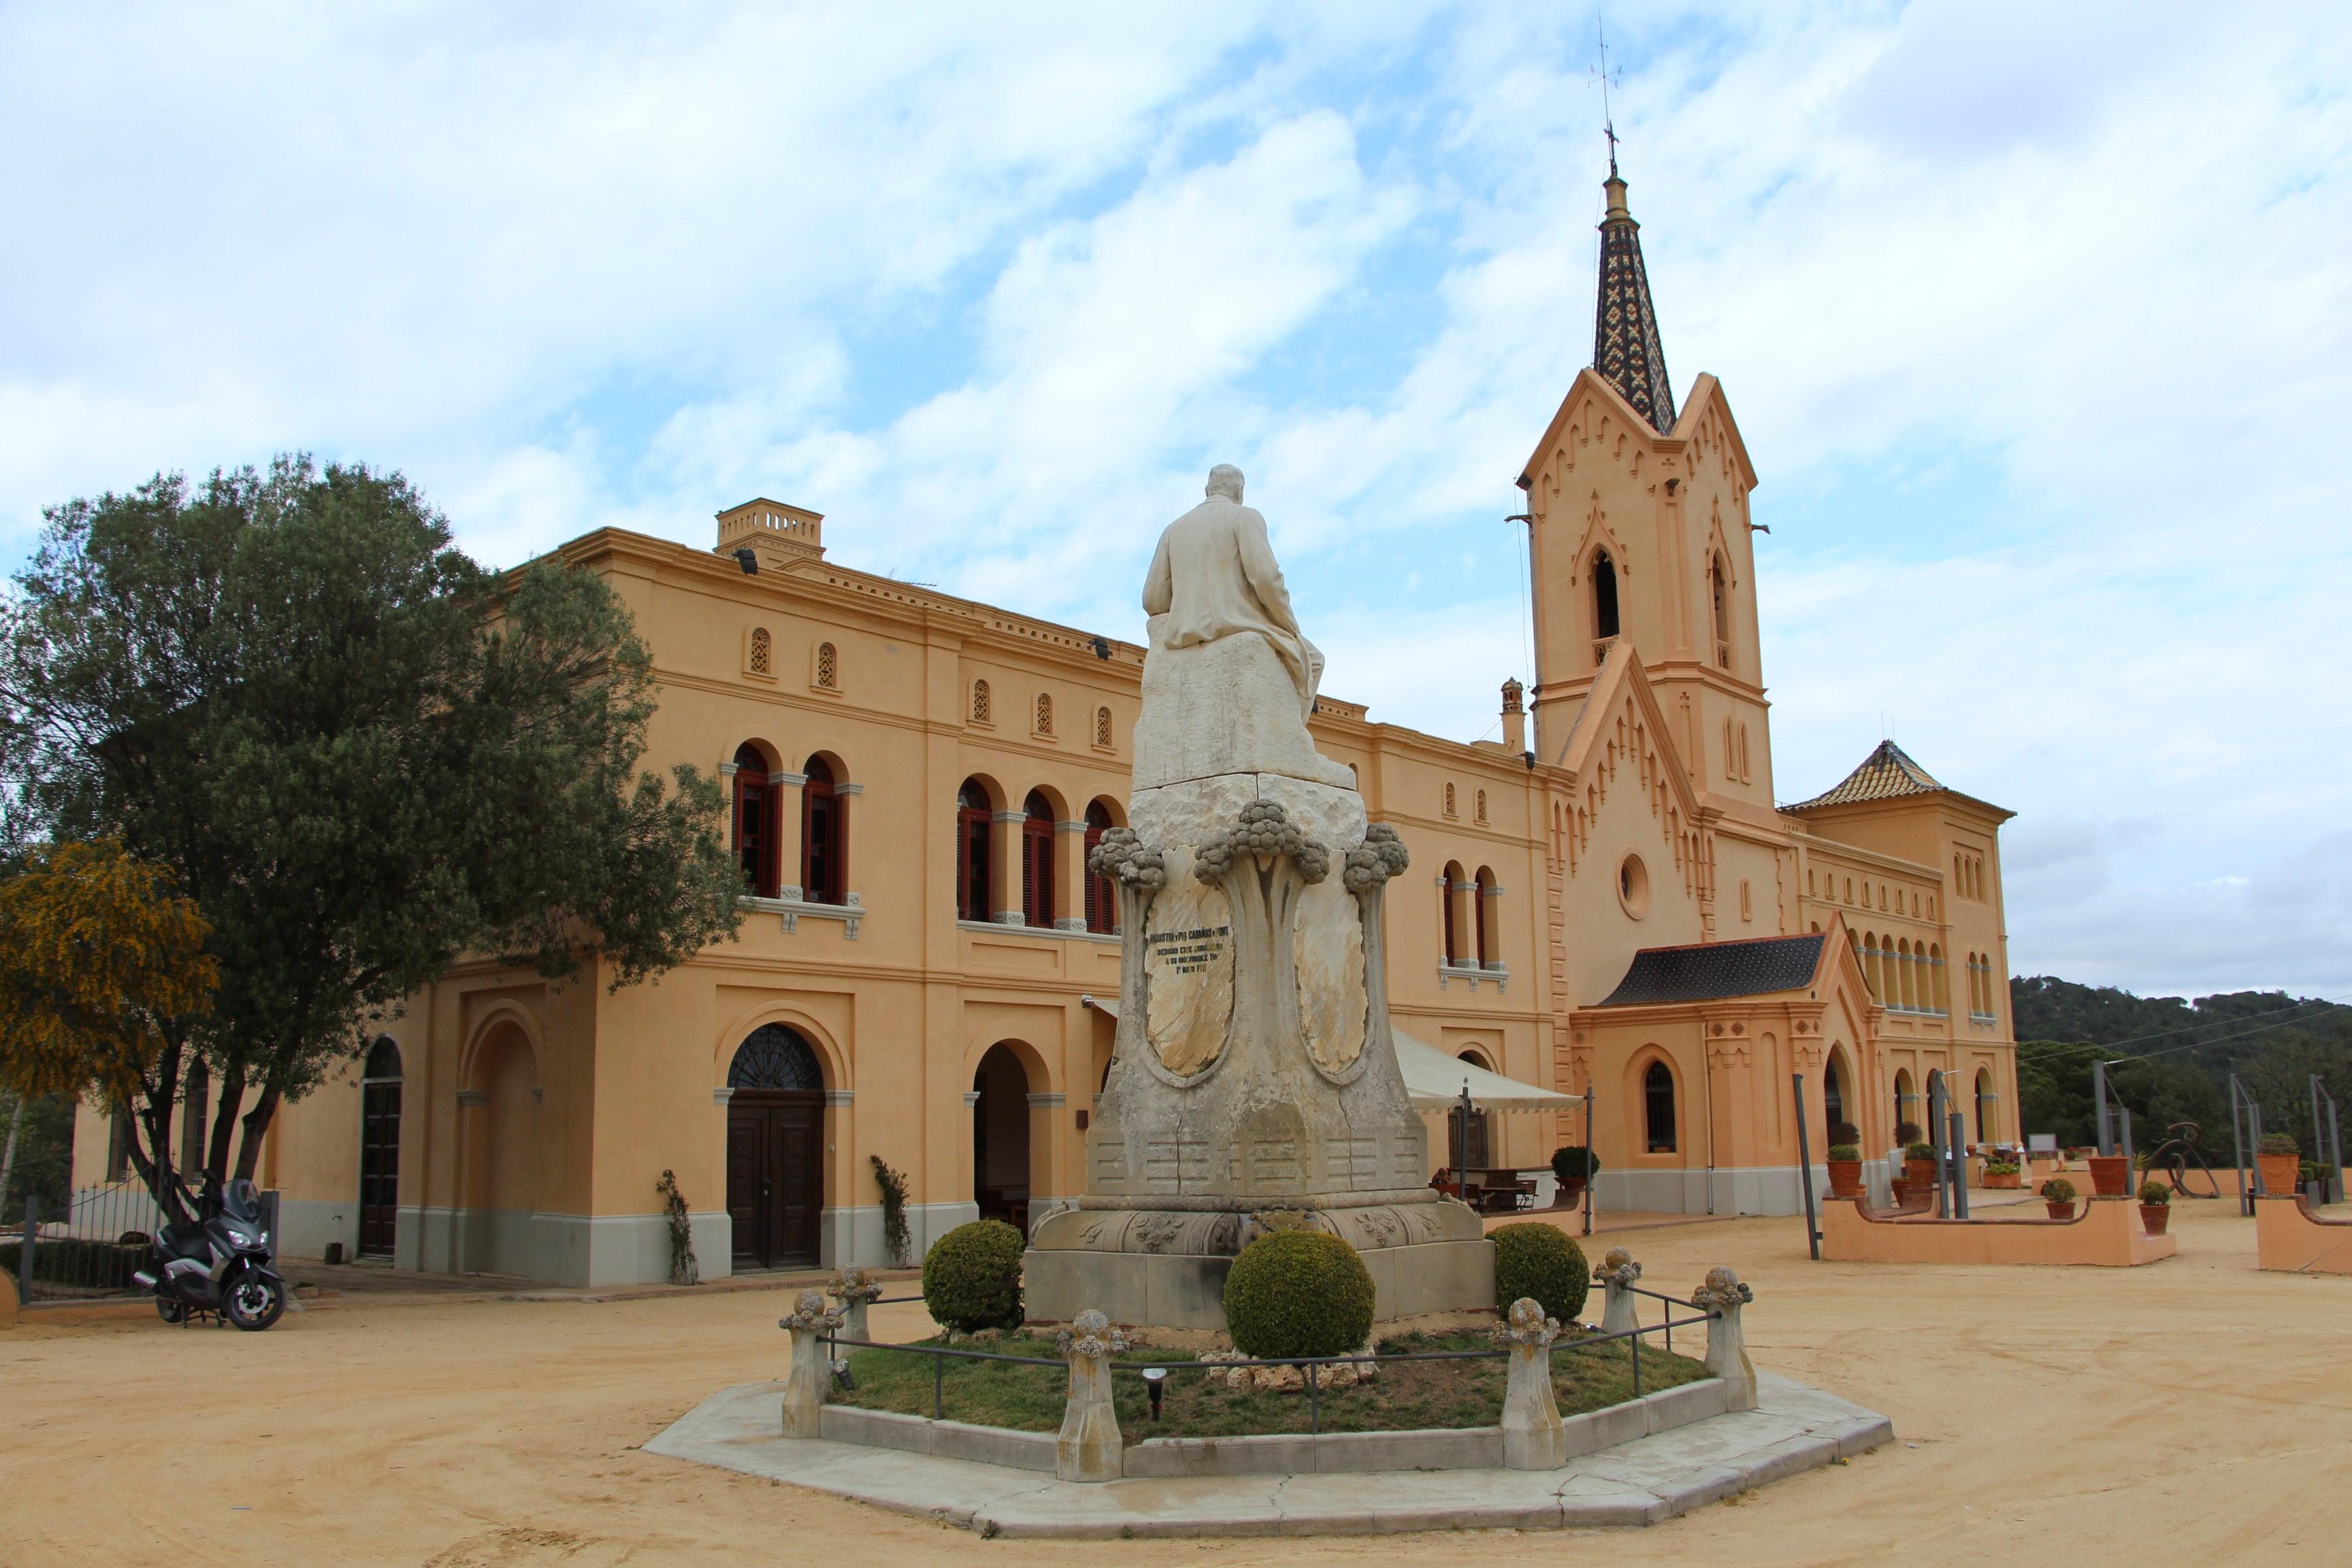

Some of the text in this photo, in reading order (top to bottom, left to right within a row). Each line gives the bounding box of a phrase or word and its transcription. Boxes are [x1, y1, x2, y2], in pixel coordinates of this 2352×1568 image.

[1178, 931, 1187, 942] PIO
[1180, 945, 1192, 953] ESTE
[1171, 956, 1177, 964] SU
[1182, 965, 1195, 973] MAYO
